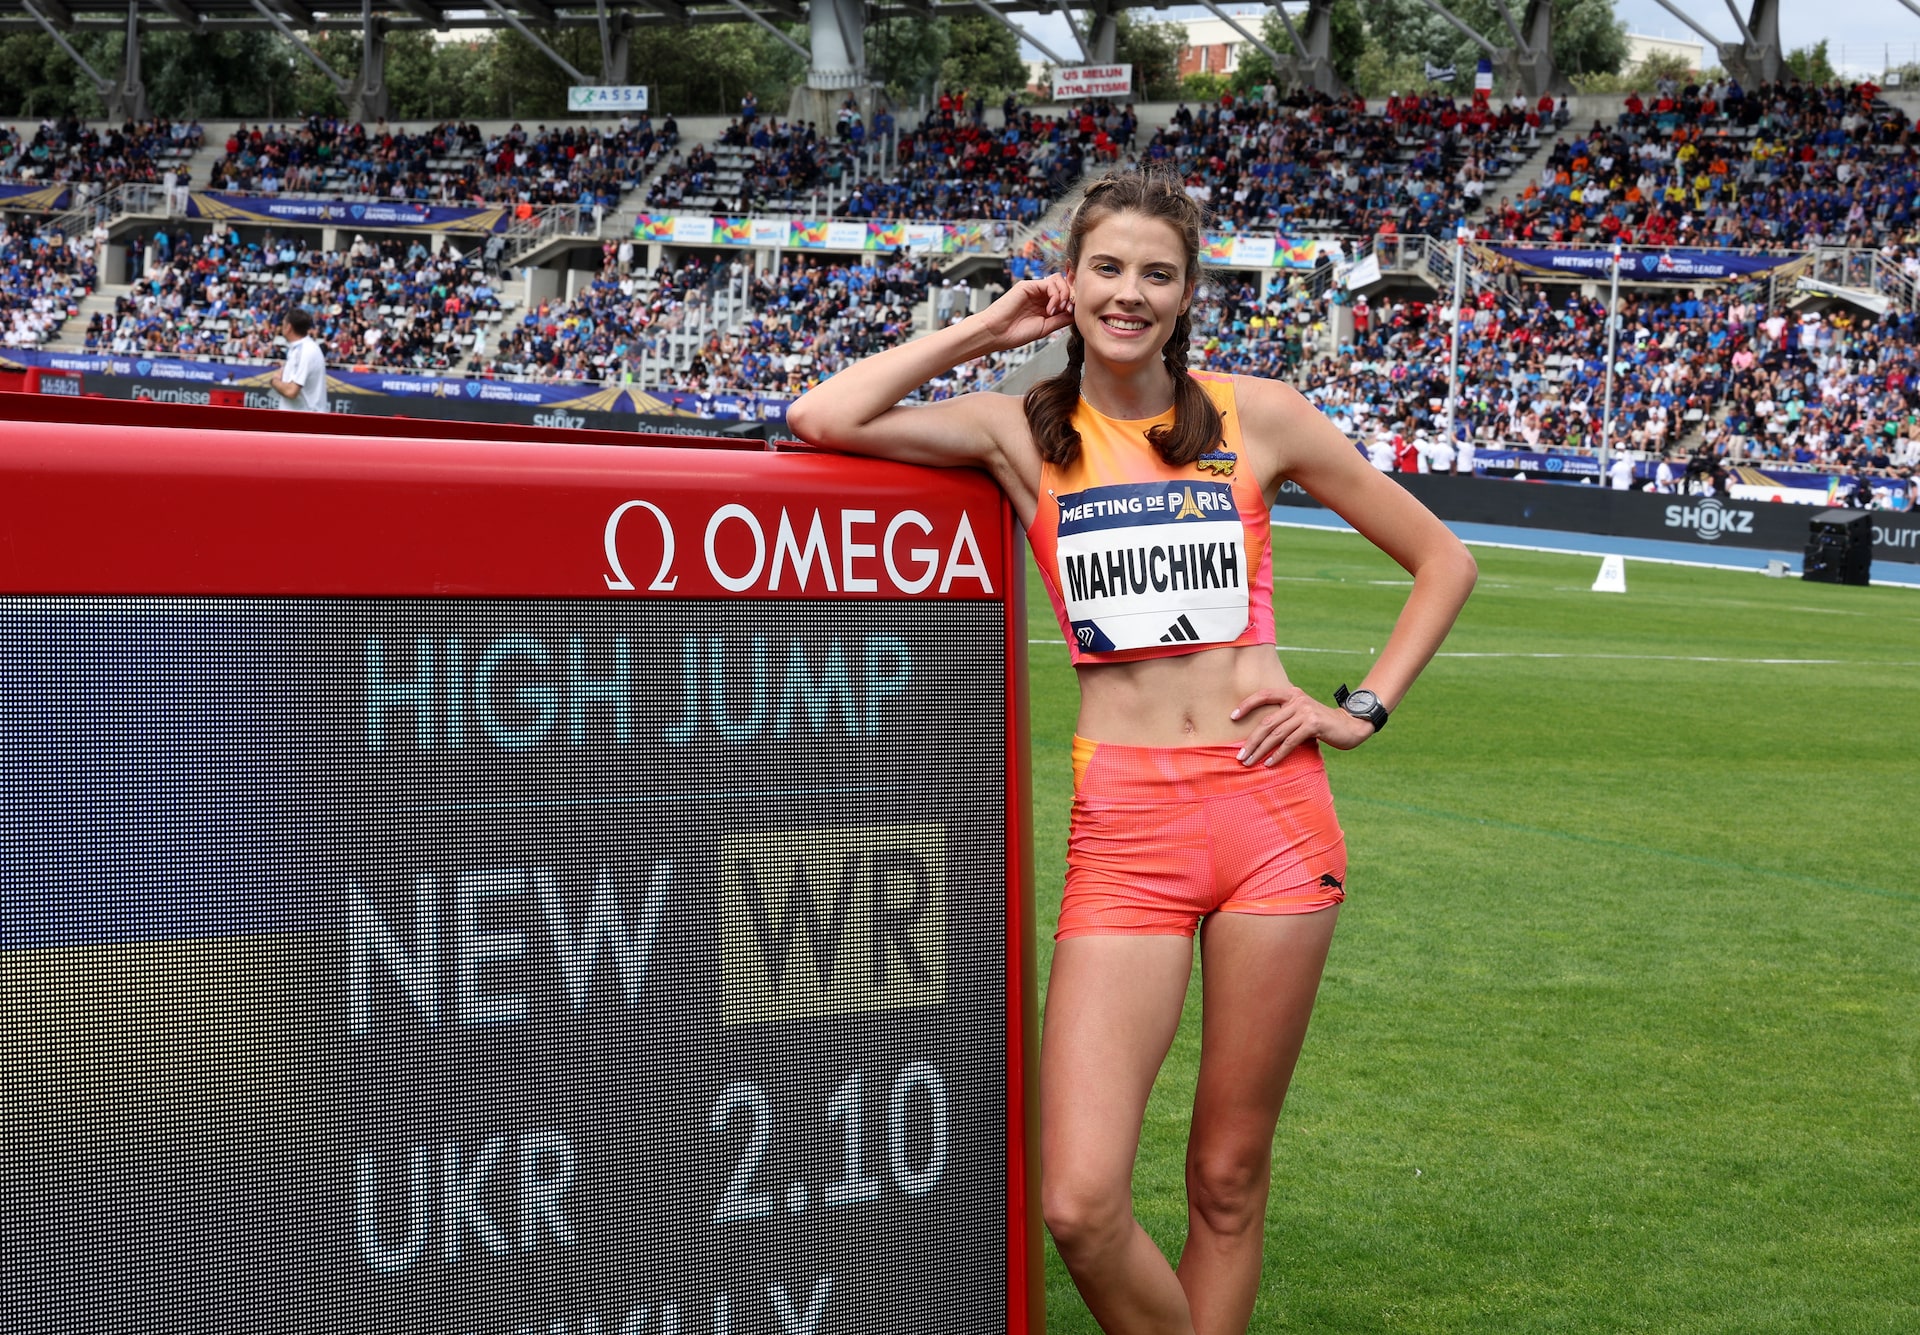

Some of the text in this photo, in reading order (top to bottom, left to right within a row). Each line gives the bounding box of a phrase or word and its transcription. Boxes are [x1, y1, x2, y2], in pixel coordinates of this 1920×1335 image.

[1063, 68, 1122, 80] US MELUN
[1057, 82, 1129, 95] ATHLETISME
[1604, 257, 1636, 271] PRIS
[51, 359, 90, 371] MEETING
[382, 380, 421, 392] MEETING
[533, 413, 585, 430] SHOKZ
[1061, 487, 1233, 524] MEETING DE PARIS
[1665, 505, 1754, 533] SHOKZ
[703, 503, 995, 594] OMEGA
[1066, 542, 1239, 602] MAHUCHIKH
[368, 633, 914, 751] HIGH JUMP
[347, 848, 932, 1036] NEW WR
[358, 1060, 948, 1274] UKR 2.10
